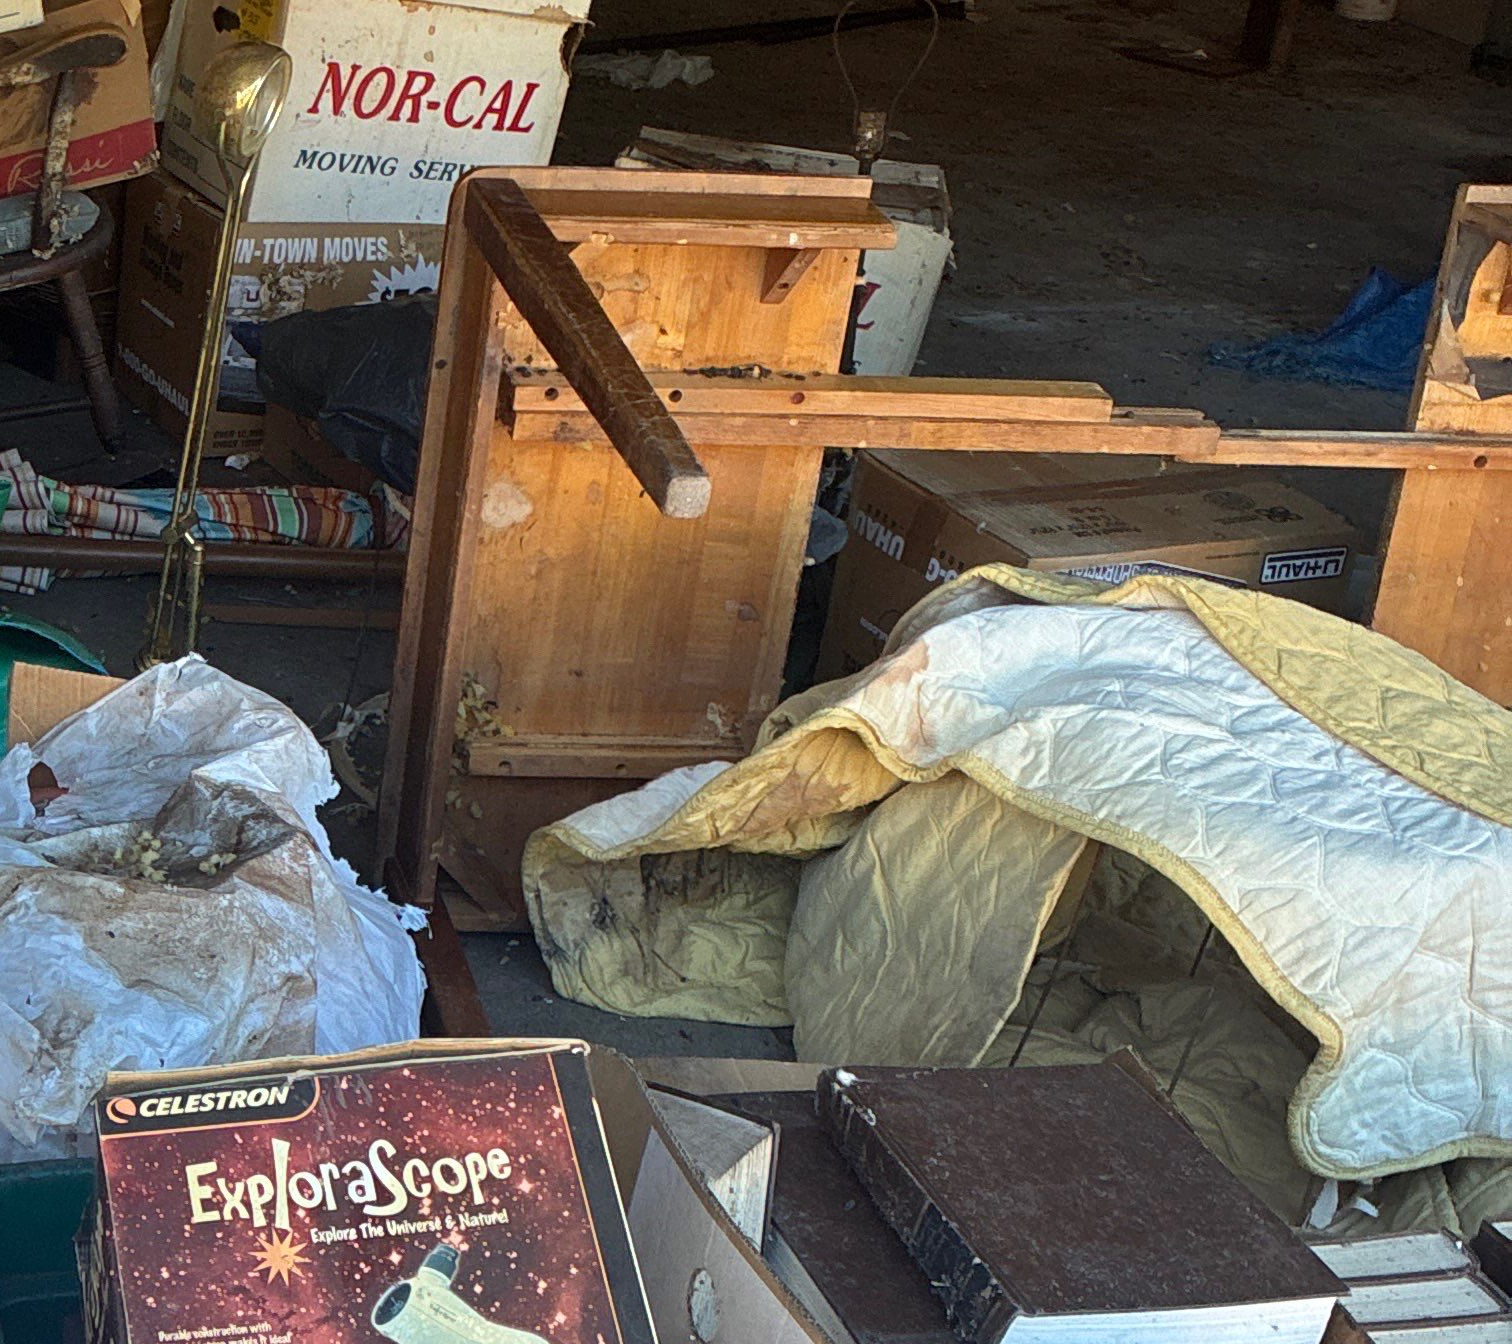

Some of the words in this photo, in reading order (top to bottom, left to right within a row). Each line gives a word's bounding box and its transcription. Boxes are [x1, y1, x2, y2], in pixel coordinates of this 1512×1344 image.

[308, 61, 540, 133] NOR-CAL
[294, 149, 398, 177] MOVING
[409, 159, 474, 183] SERV
[322, 236, 390, 264] MOVES
[1264, 557, 1341, 580] U-HAUL
[140, 1085, 290, 1118] CELESTRON
[185, 1138, 513, 1233] ExploraScope
[310, 1226, 358, 1246] Explore
[359, 1221, 385, 1239] The
[386, 1215, 442, 1237] Universe
[458, 1208, 509, 1228] Nature!
[158, 1329, 191, 1342] Durable
[192, 1322, 249, 1339] construction
[249, 1321, 272, 1333] with
[269, 1331, 293, 1344] ideal
